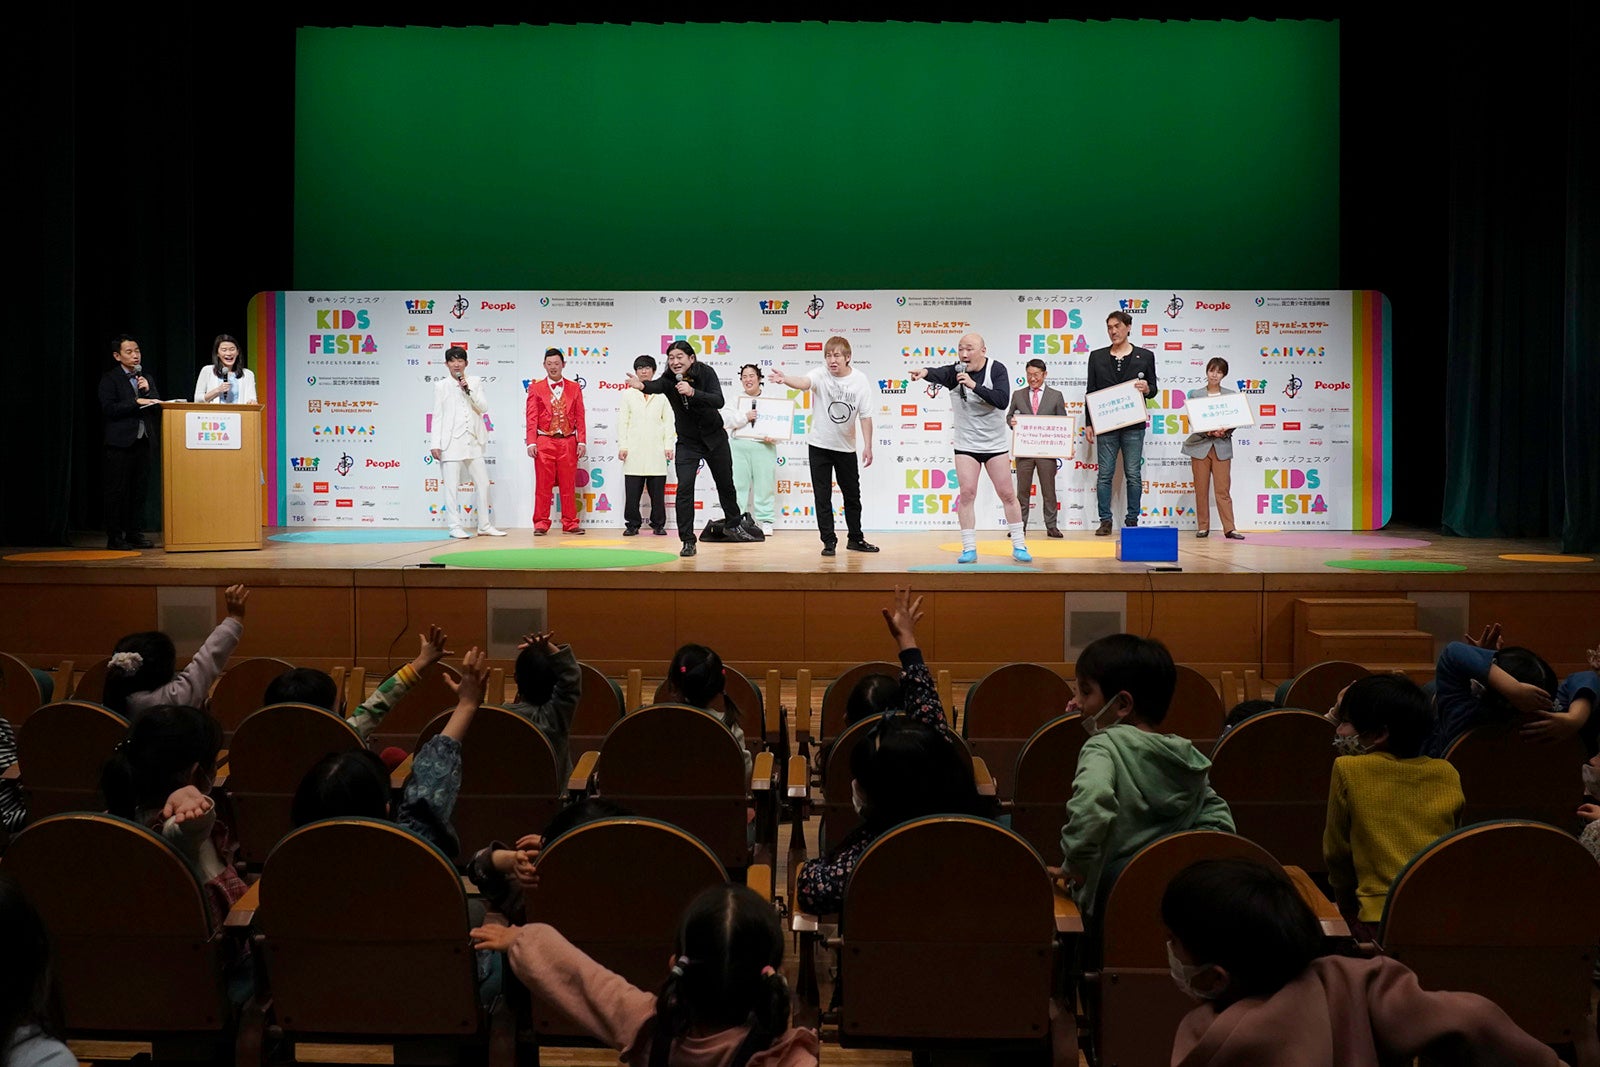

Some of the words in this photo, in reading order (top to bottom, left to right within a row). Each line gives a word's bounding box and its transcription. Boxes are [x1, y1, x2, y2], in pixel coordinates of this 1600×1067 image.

[405, 299, 435, 310] KIDS
[481, 301, 516, 311] People
[759, 299, 790, 310] KIDS
[836, 301, 872, 311] People
[1195, 301, 1231, 311] People
[316, 309, 371, 330] KIDS
[668, 309, 724, 330] KIDS
[1026, 308, 1083, 330] KIDS
[309, 333, 378, 355] FESTA
[1019, 333, 1090, 355] FESTA
[901, 346, 958, 357] CANVA
[1260, 346, 1325, 357] CANVAS
[878, 379, 909, 389] KIDS
[1236, 379, 1268, 389] KIDS
[1314, 380, 1351, 391] People
[201, 421, 226, 431] KIDS
[312, 425, 376, 436] CANVAS
[198, 432, 229, 441] FESTA
[290, 456, 320, 467] KIDS
[365, 459, 400, 470] People
[1264, 468, 1321, 489] KIDS
[1256, 493, 1329, 515] FESTA
